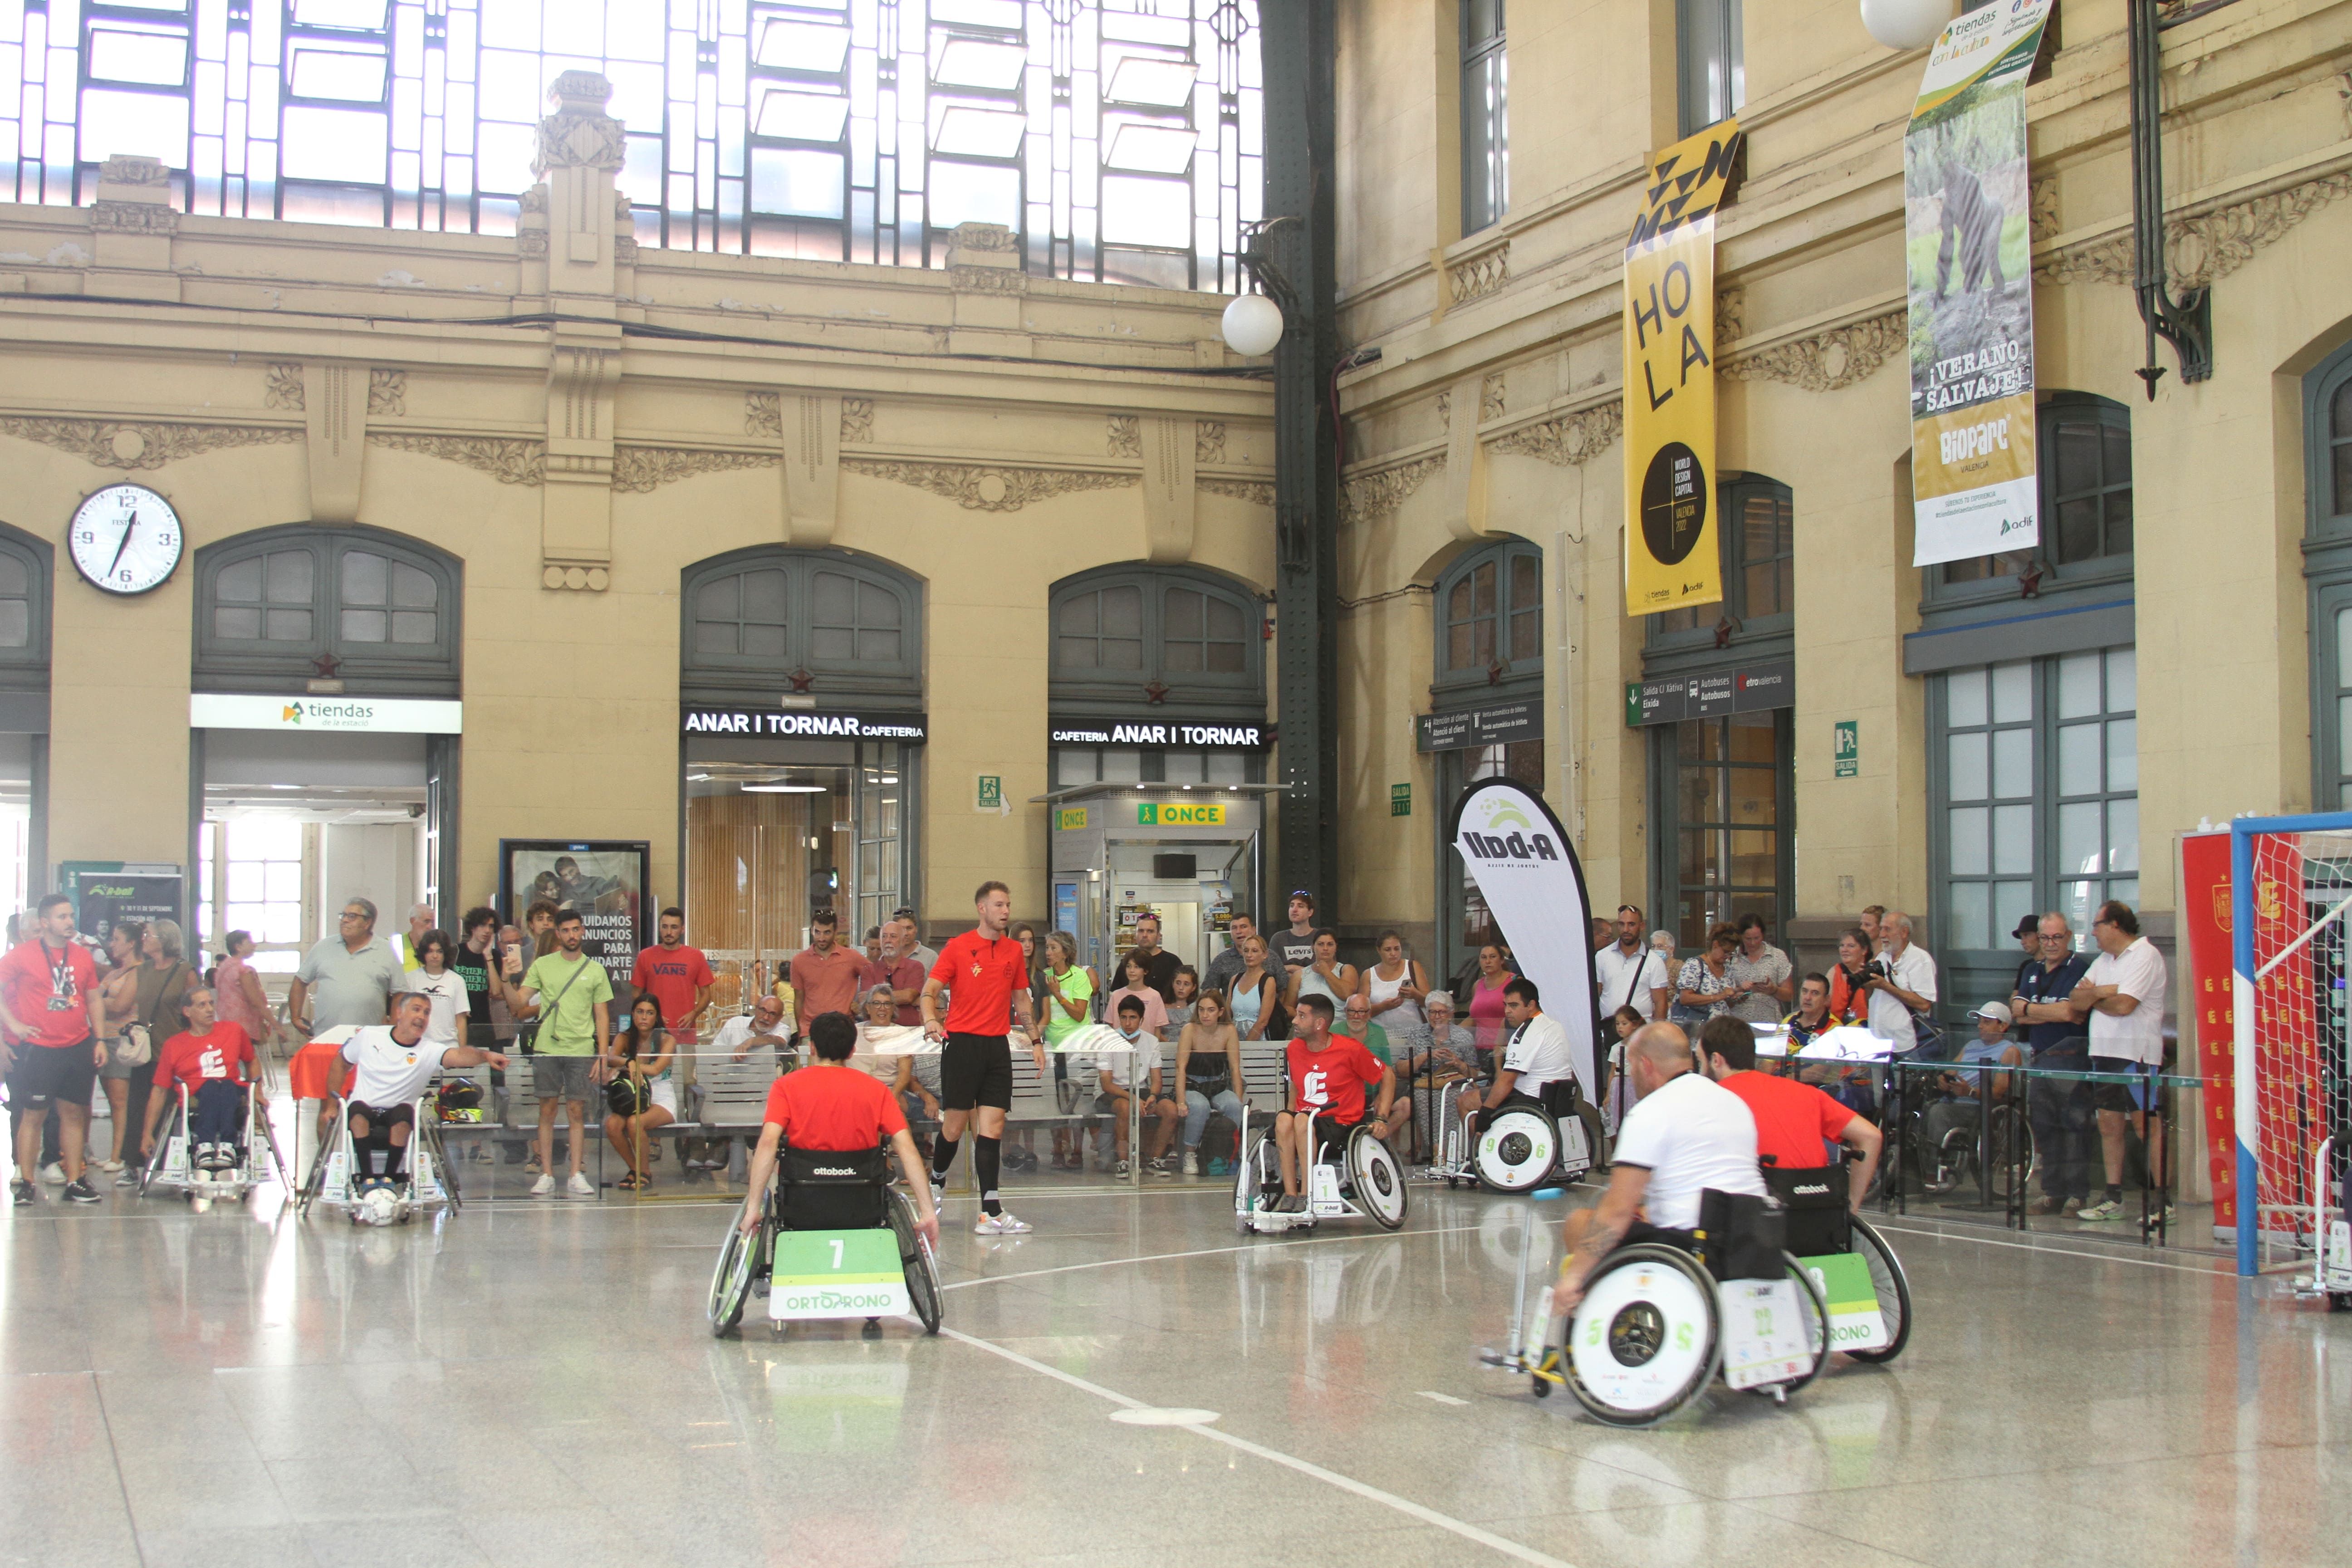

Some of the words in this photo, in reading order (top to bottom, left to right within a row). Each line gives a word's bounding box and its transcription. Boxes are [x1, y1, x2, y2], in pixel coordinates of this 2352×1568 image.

[1955, 10, 1996, 35] tiendas
[2000, 51, 2028, 65] SORTEAMOS
[1930, 340, 2019, 389] ¡VERANO
[1926, 367, 2022, 412] SALVAJE!
[1675, 457, 1690, 471] WORLD
[1960, 461, 1989, 473] VALENCIA
[1675, 470, 1691, 484] DESIGN
[1675, 482, 1693, 497] CAPITAL
[117, 495, 137, 508] 12
[1970, 491, 1996, 502] EXPERIENCIA
[1676, 505, 1695, 519] VALENCIA
[1676, 519, 1687, 532] 2022
[2011, 515, 2033, 529] adif
[82, 531, 94, 544] 9
[159, 534, 171, 546] 3
[120, 570, 132, 582] 6
[1651, 589, 1670, 598] tiendas
[1689, 582, 1704, 592] adif
[1701, 676, 1730, 689] Autobuses
[1643, 686, 1658, 697] Salida
[1659, 684, 1665, 694] C/
[1666, 683, 1683, 693] Xàtiva
[1701, 690, 1730, 701] Autobusos
[1643, 698, 1660, 709] Eixida
[309, 703, 373, 718] tiendas
[686, 713, 750, 733] ANAR
[755, 715, 761, 733] I
[767, 715, 860, 736] TORNAR
[862, 726, 924, 737] CAFETERIA
[1433, 715, 1450, 726] Atención
[1450, 715, 1455, 723] al
[1455, 713, 1470, 723] cliente
[1053, 731, 1109, 742] CAFETERIA
[1112, 725, 1166, 744] ANAR
[1171, 726, 1176, 744] I
[1181, 726, 1259, 745] TORNAR
[1433, 727, 1448, 737] Atenció
[1449, 726, 1453, 735] al
[1453, 724, 1465, 734] client
[1836, 761, 1856, 770] SALIDA
[1392, 787, 1409, 796] SALIDA
[1063, 811, 1085, 828] ONCE
[1165, 808, 1219, 822] ONCE
[581, 930, 632, 940] NUNCIOS
[604, 943, 632, 954] PARA
[612, 970, 620, 981] A
[624, 970, 632, 981] TI
[653, 963, 687, 975] VANS
[1486, 1137, 1496, 1152] 9
[1322, 1185, 1328, 1198] 1
[829, 1239, 844, 1269] 7
